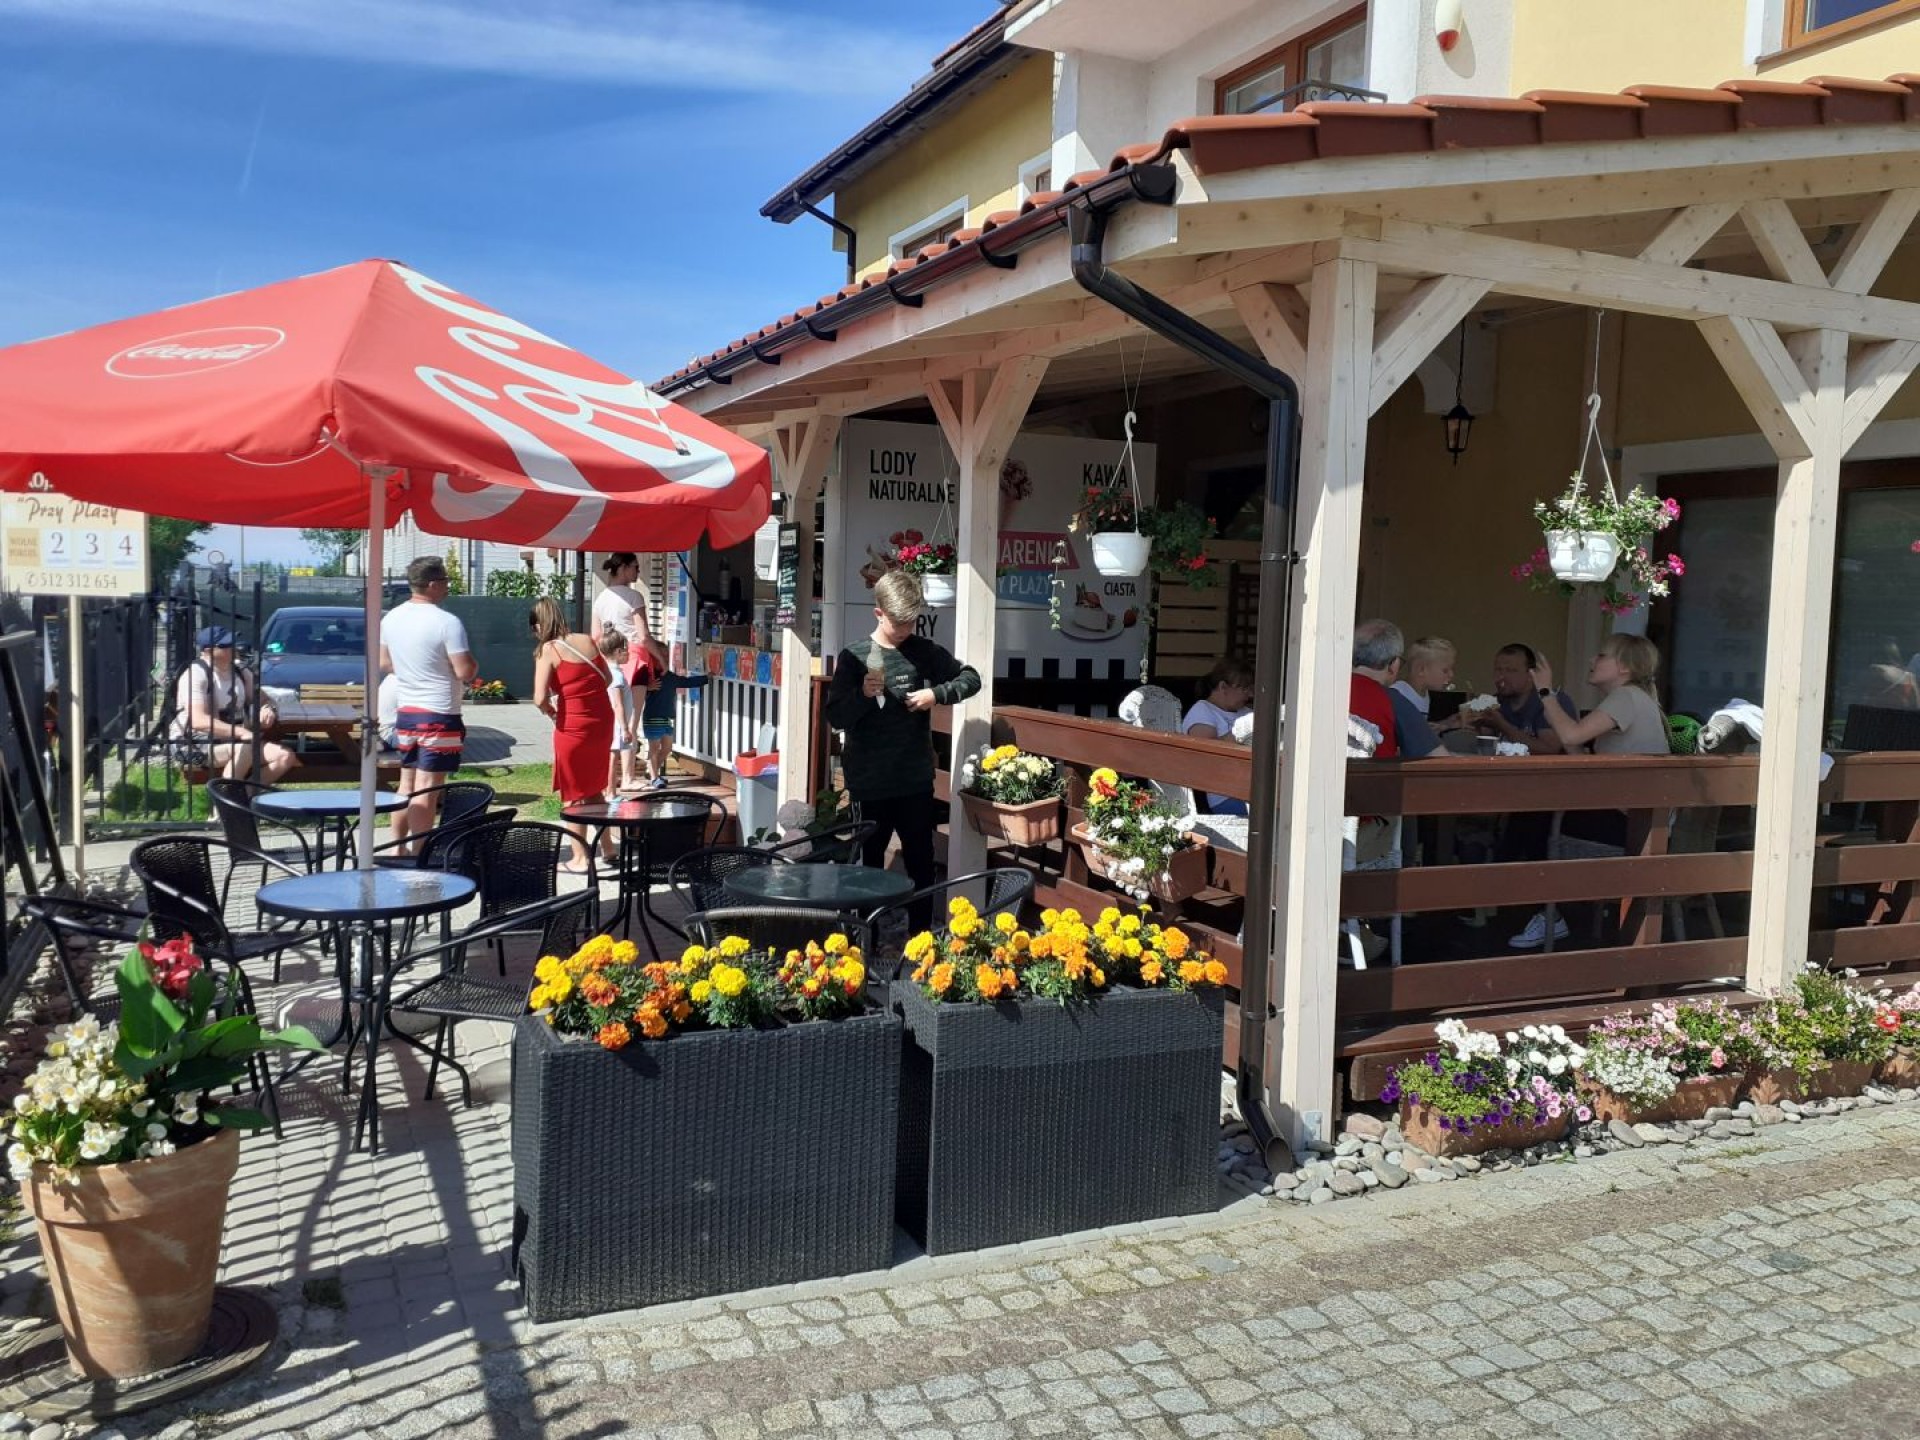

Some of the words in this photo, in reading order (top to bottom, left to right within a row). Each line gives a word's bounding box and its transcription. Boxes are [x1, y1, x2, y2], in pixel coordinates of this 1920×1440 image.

[870, 449, 917, 476] LODY
[1083, 463, 1128, 488] KAWA
[869, 479, 955, 504] NATURALNE
[51, 532, 64, 554] 2
[86, 533, 98, 555] 3
[118, 535, 132, 556] 4
[1104, 582, 1136, 597] CIASTA
